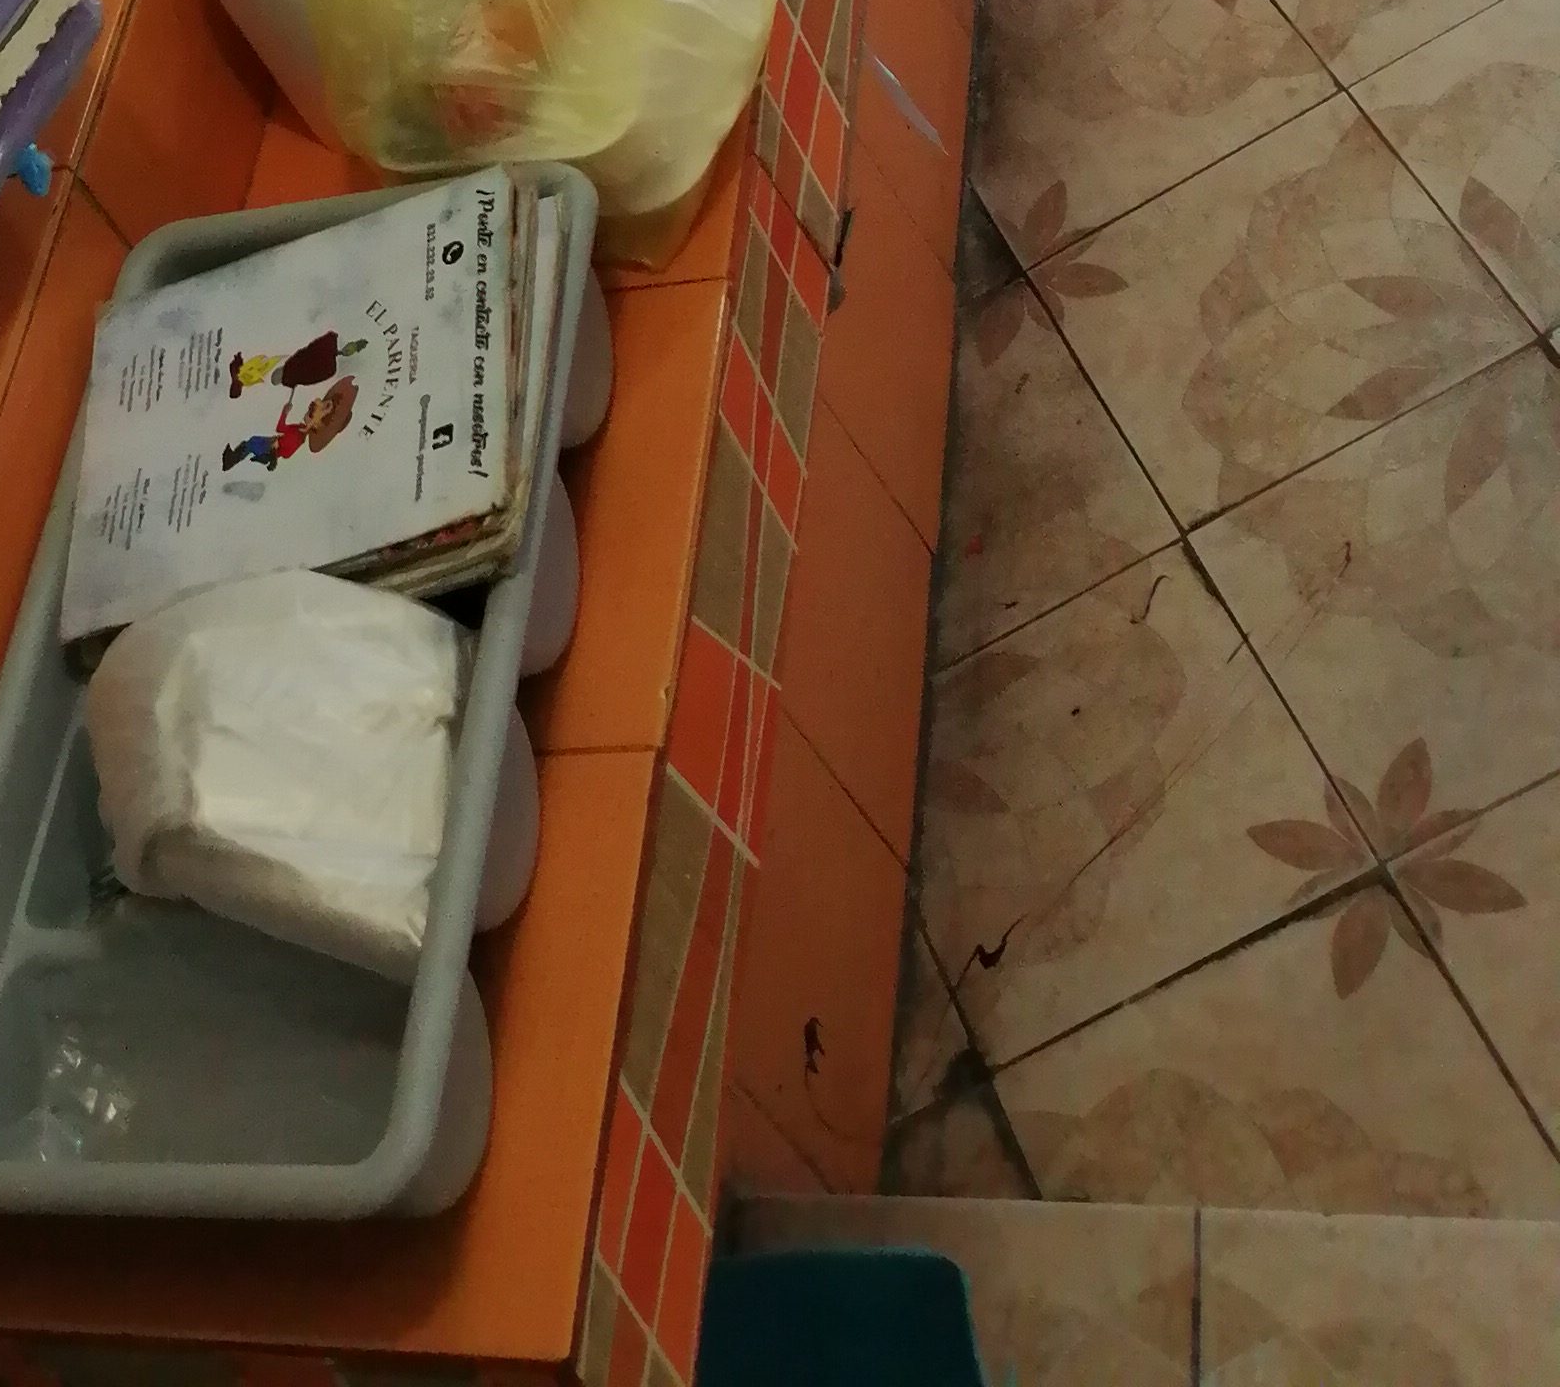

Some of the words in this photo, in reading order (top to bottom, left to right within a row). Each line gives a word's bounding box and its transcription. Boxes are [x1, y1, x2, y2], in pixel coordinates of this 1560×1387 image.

[477, 253, 488, 275] en
[365, 300, 387, 326] EL
[475, 280, 492, 350] contacto
[358, 323, 403, 441] PARIENTE
[408, 326, 419, 385] TAQUERIA
[473, 355, 485, 388] con
[468, 393, 489, 478] nosotros!
